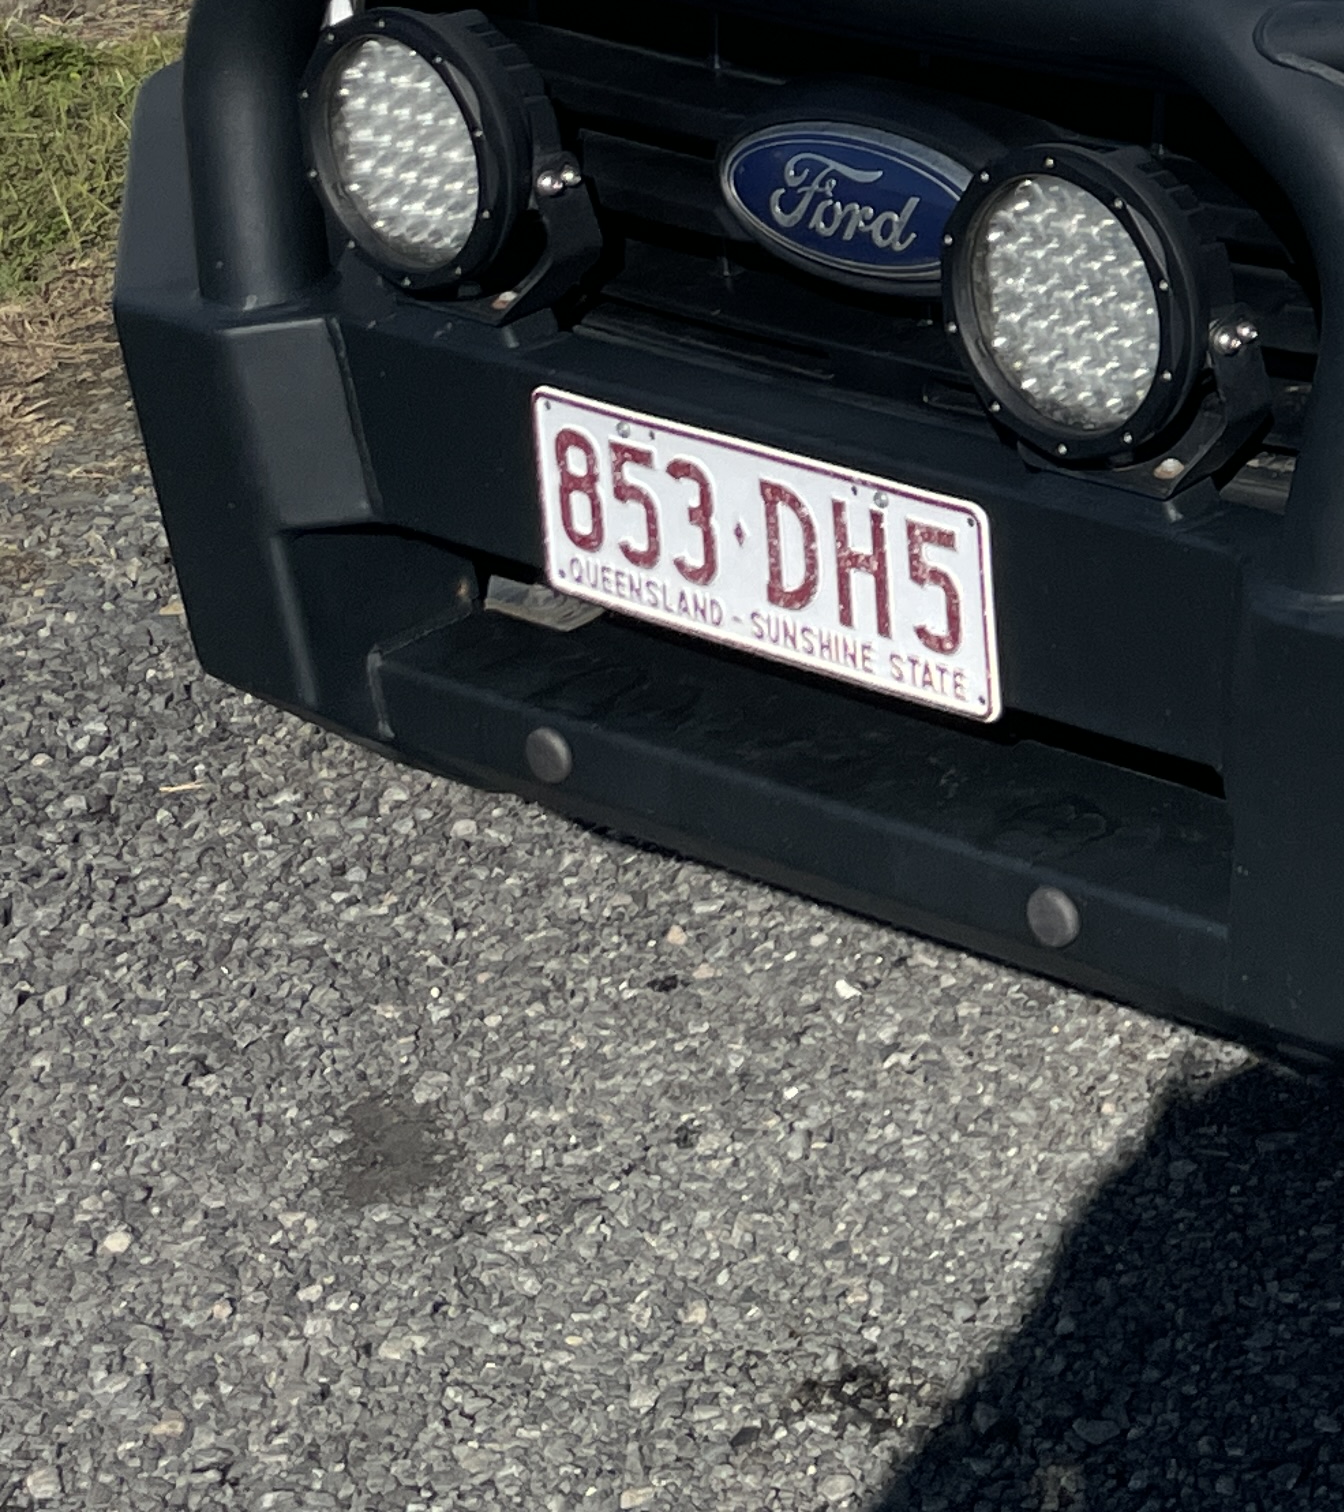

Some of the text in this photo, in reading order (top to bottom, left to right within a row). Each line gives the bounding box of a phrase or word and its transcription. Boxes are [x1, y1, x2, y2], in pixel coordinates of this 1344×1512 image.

[769, 152, 920, 251] Ford
[569, 556, 724, 628] QUEENSLAND
[750, 611, 876, 675] SUNSHINE
[889, 654, 970, 702] STATE
